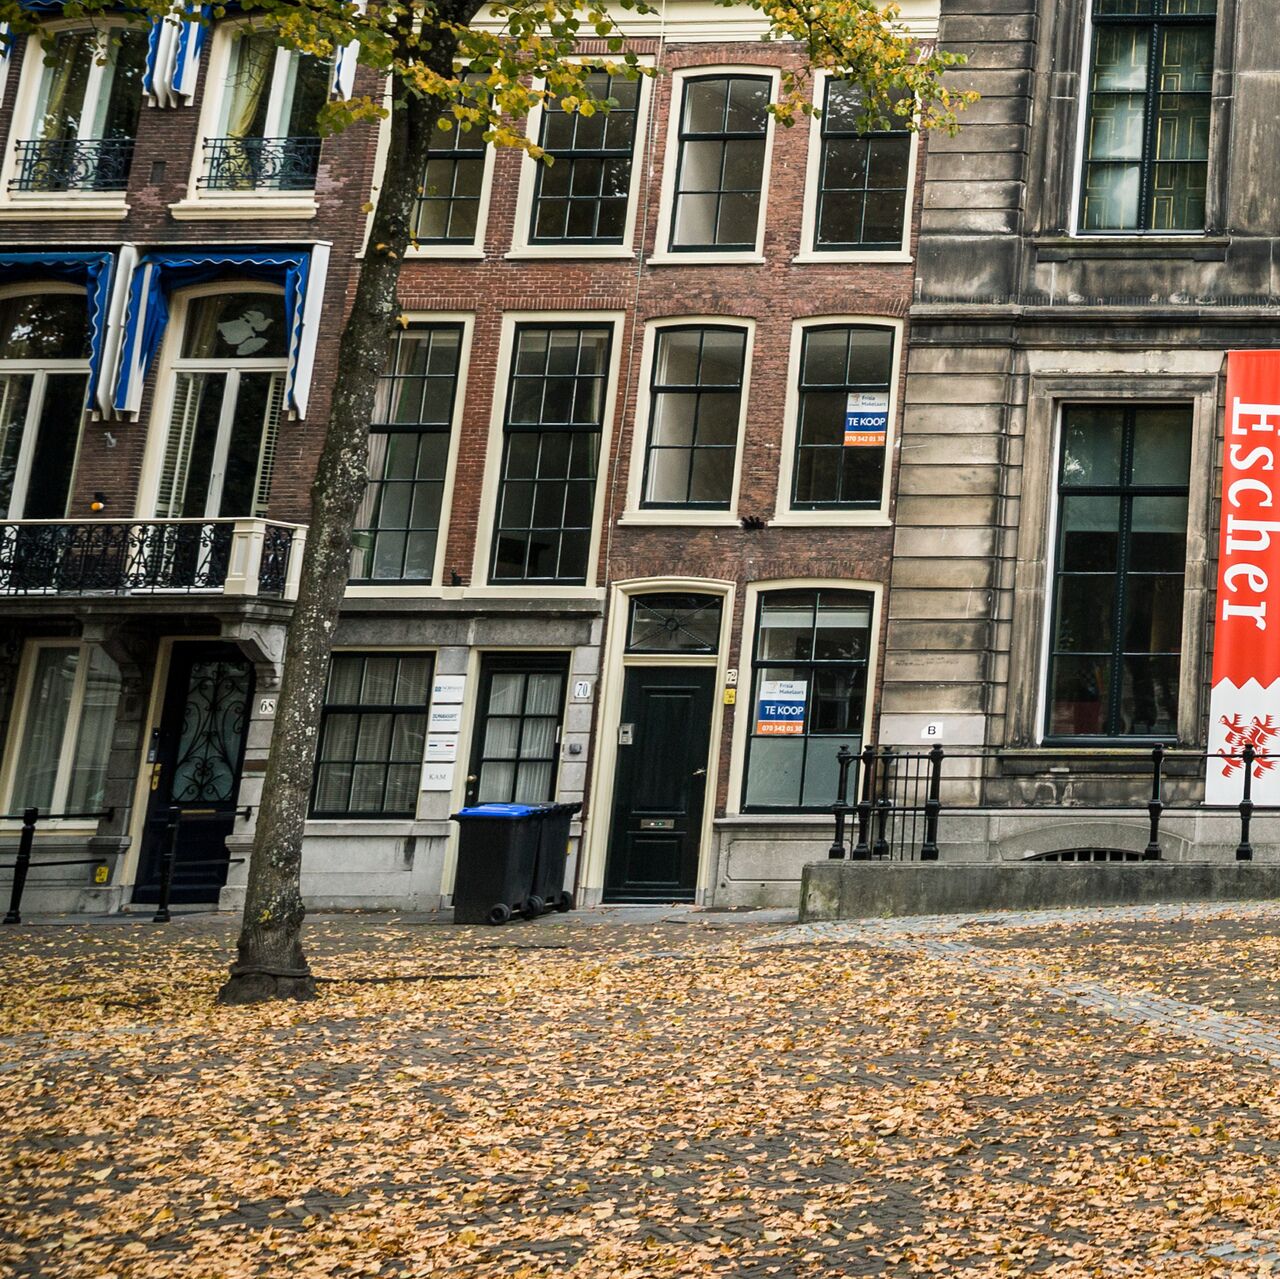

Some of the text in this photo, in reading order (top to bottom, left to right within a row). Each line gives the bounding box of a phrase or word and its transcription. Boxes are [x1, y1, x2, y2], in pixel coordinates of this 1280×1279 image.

[848, 417, 886, 426] TE KOOP
[727, 671, 736, 682] 72
[577, 683, 588, 696] 70
[260, 700, 274, 713] 68
[765, 705, 804, 716] TE KOOP
[927, 725, 936, 735] B
